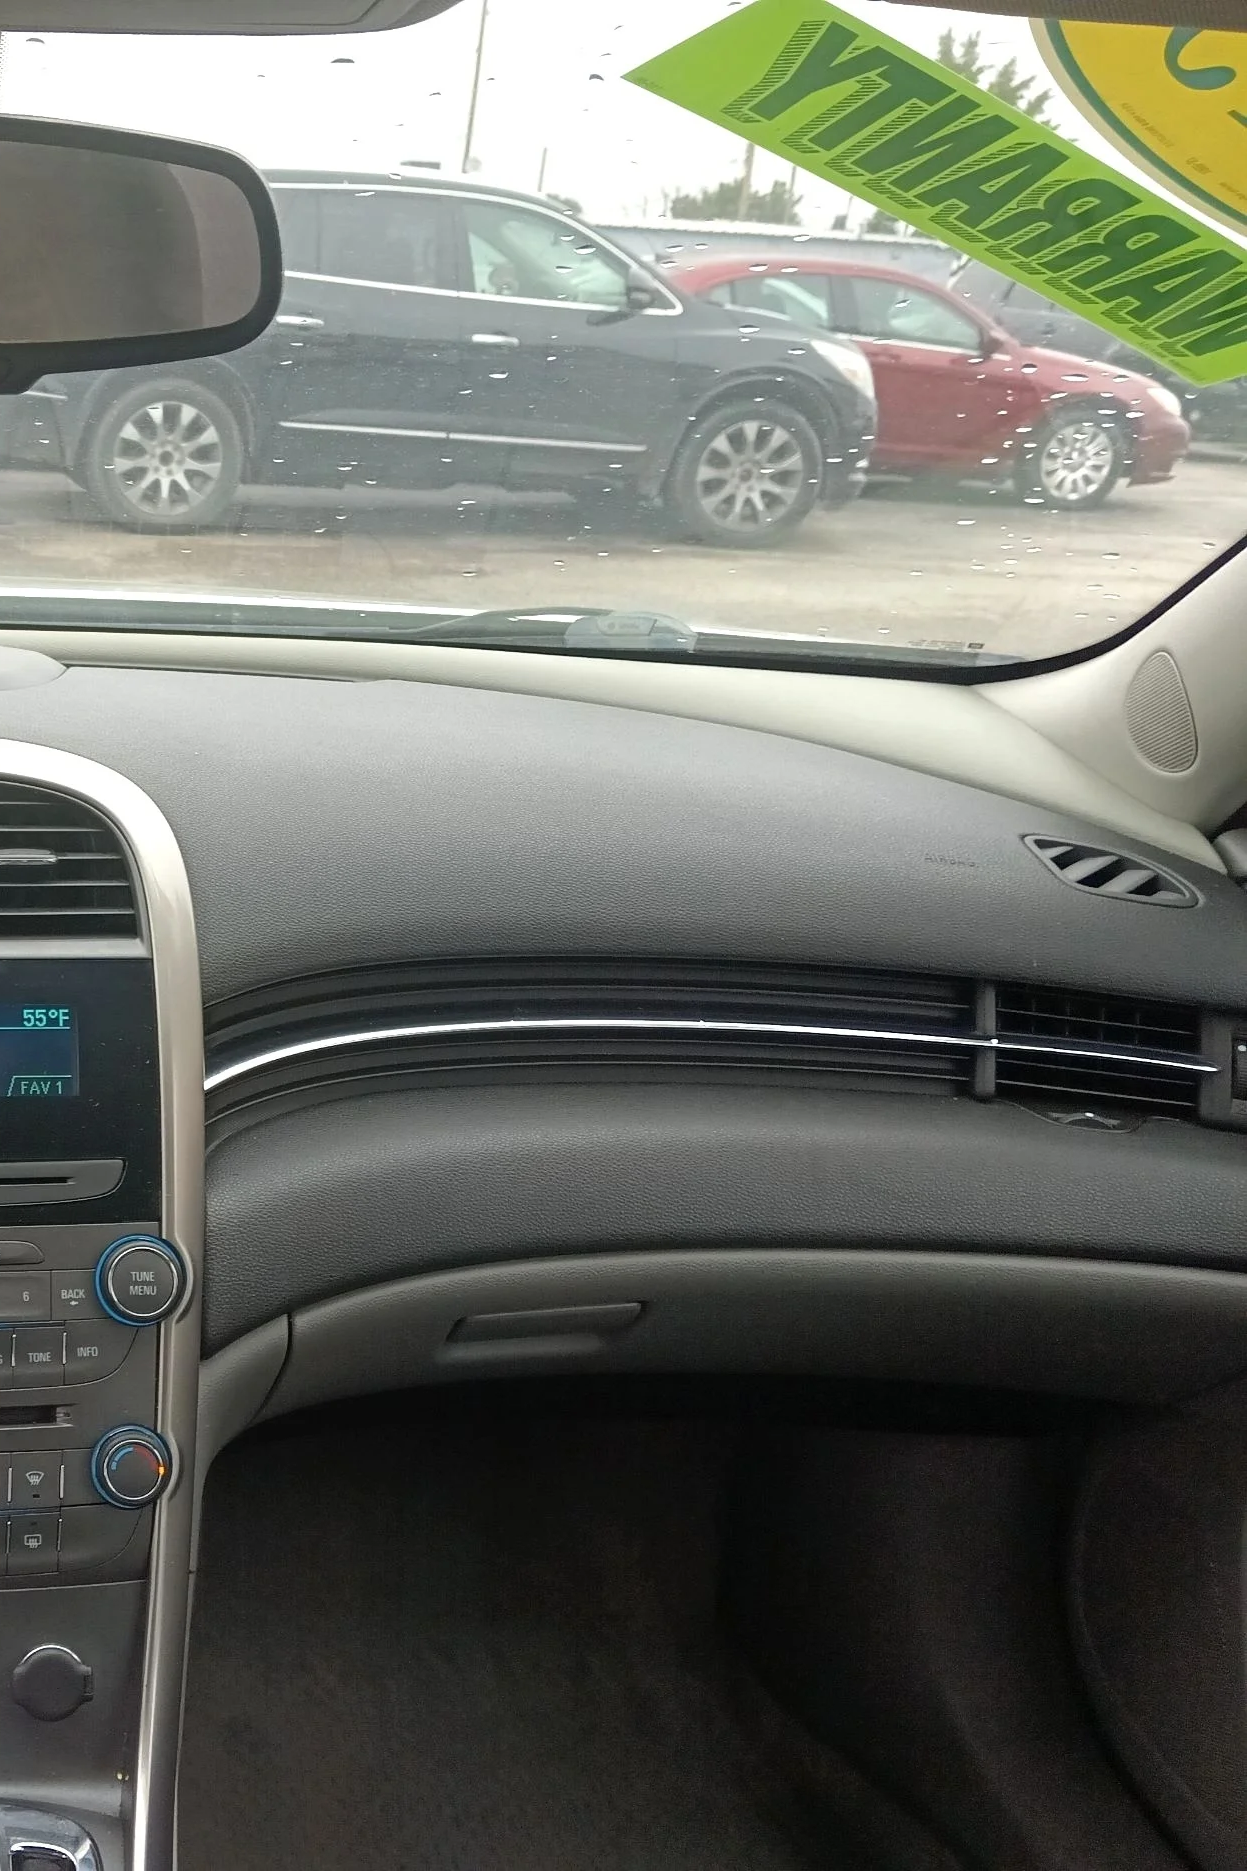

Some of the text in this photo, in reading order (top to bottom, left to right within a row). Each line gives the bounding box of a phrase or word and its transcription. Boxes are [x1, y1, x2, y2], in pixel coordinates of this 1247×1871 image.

[23, 1009, 70, 1027] 55°F
[20, 1081, 63, 1095] FAV 1
[130, 1271, 155, 1282] TUNE
[61, 1289, 85, 1299] BACK
[129, 1285, 157, 1296] MENU
[22, 1291, 30, 1302] 6
[27, 1352, 52, 1363] TONE
[77, 1347, 98, 1357] INFO
